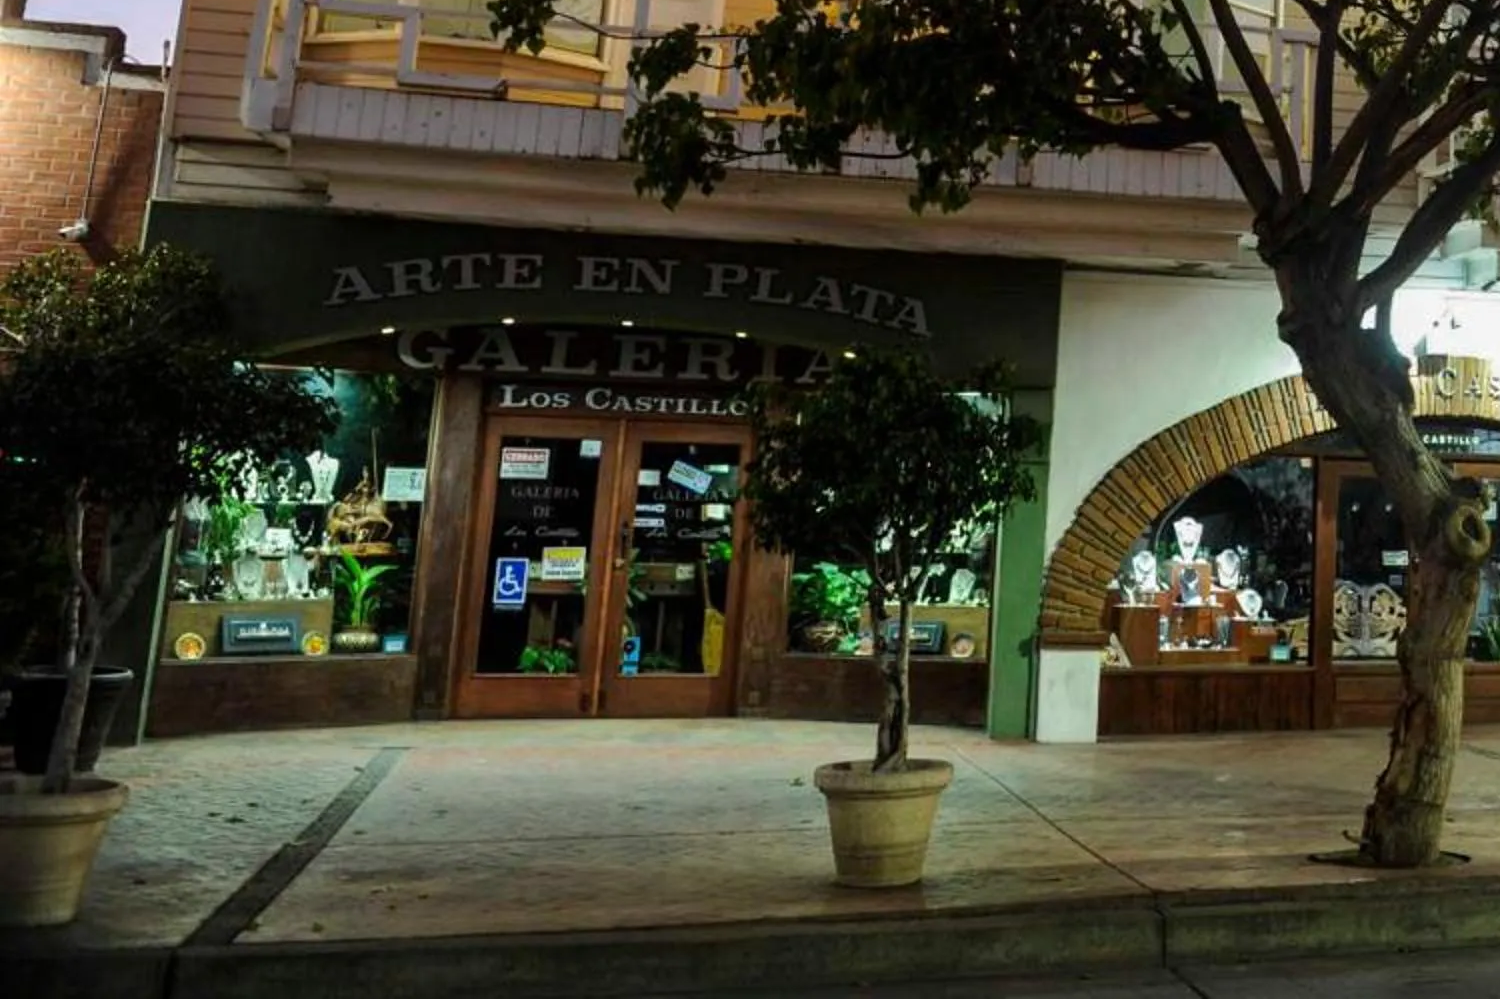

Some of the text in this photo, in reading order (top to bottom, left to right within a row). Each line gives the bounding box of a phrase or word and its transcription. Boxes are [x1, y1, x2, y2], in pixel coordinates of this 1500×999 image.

[323, 253, 933, 338] ARTE EN PLATA
[499, 384, 571, 410] LOS
[1421, 433, 1480, 447] CASTILLO
